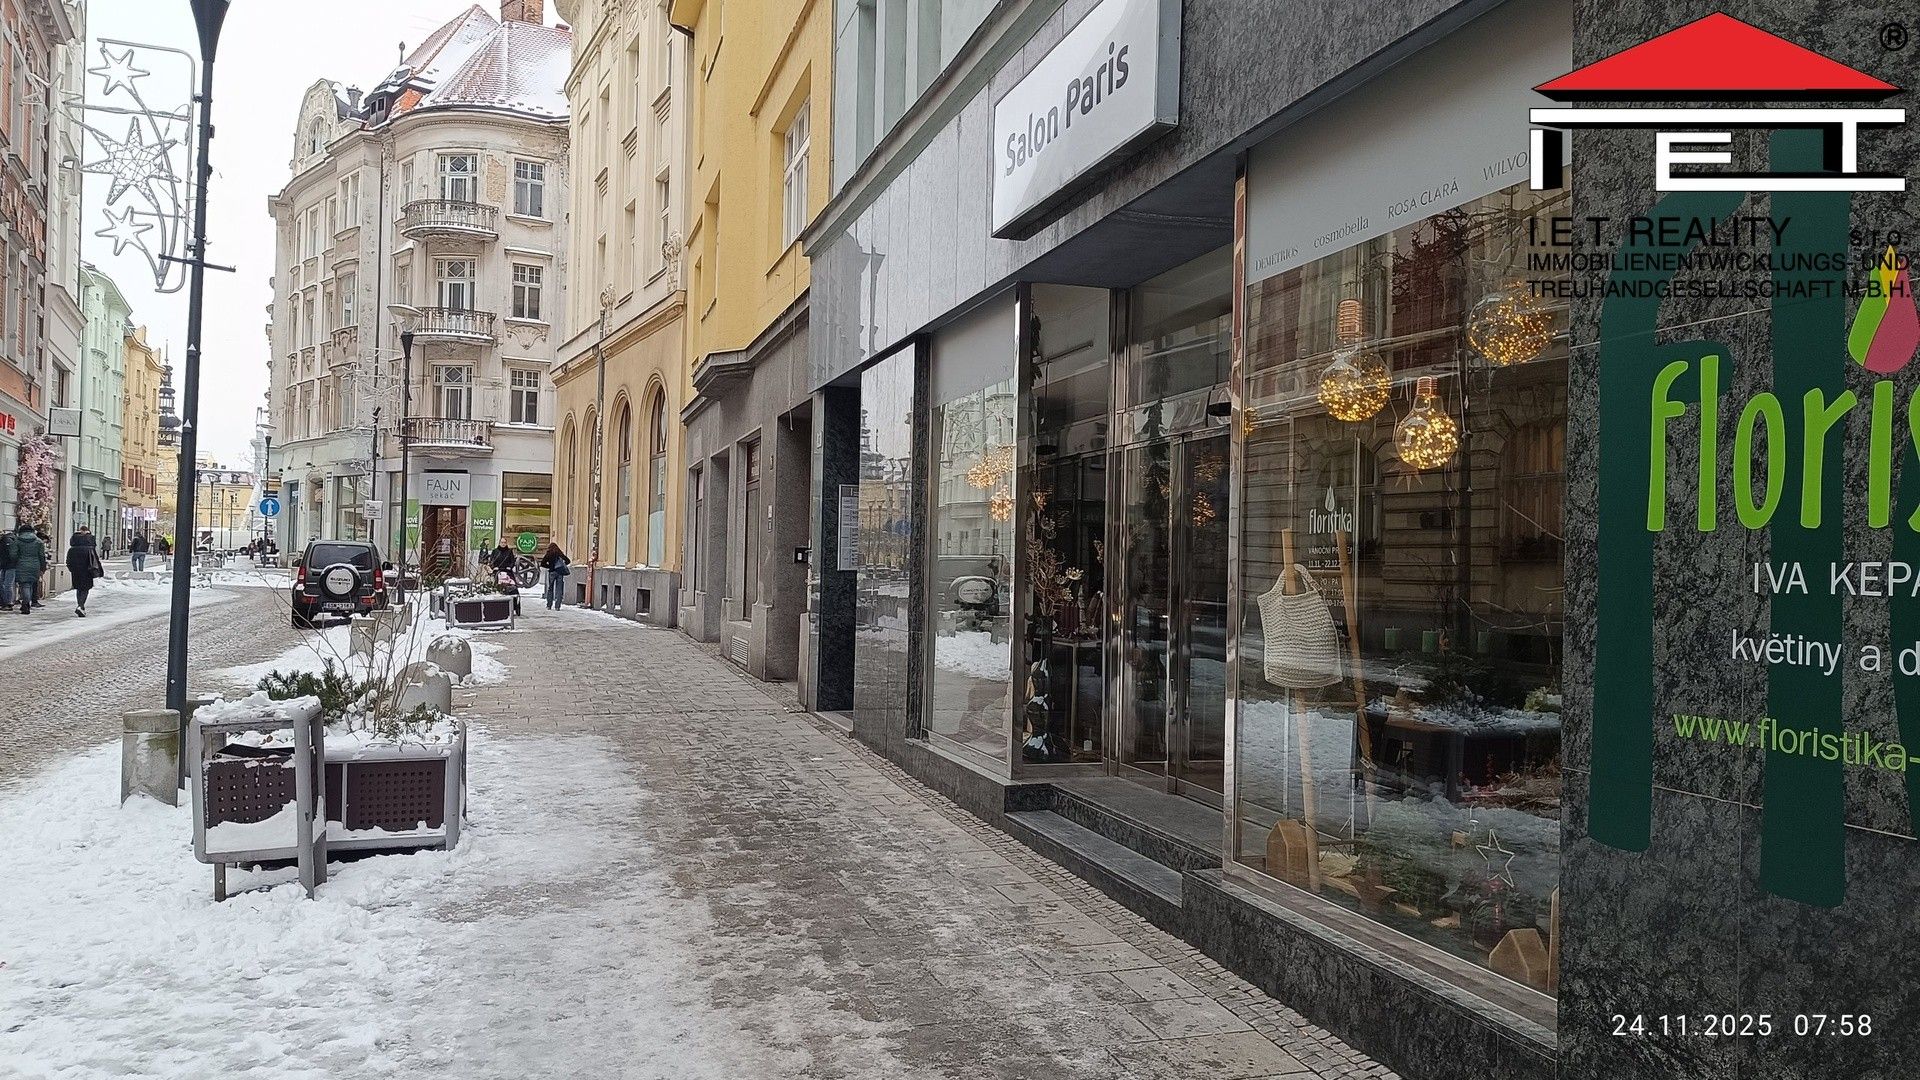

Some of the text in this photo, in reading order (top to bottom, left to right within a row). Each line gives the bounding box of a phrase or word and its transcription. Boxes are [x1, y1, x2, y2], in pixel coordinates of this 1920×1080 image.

[1005, 41, 1129, 177] Salon Paris
[1388, 177, 1459, 219] ROSA CLARÁ
[1313, 216, 1369, 249] cosmobella
[1255, 246, 1299, 271] DEMETRIOS
[426, 479, 461, 491] FAJN
[1753, 562, 1809, 594] IVA
[1731, 628, 1842, 676] květiny
[1859, 644, 1881, 672] a
